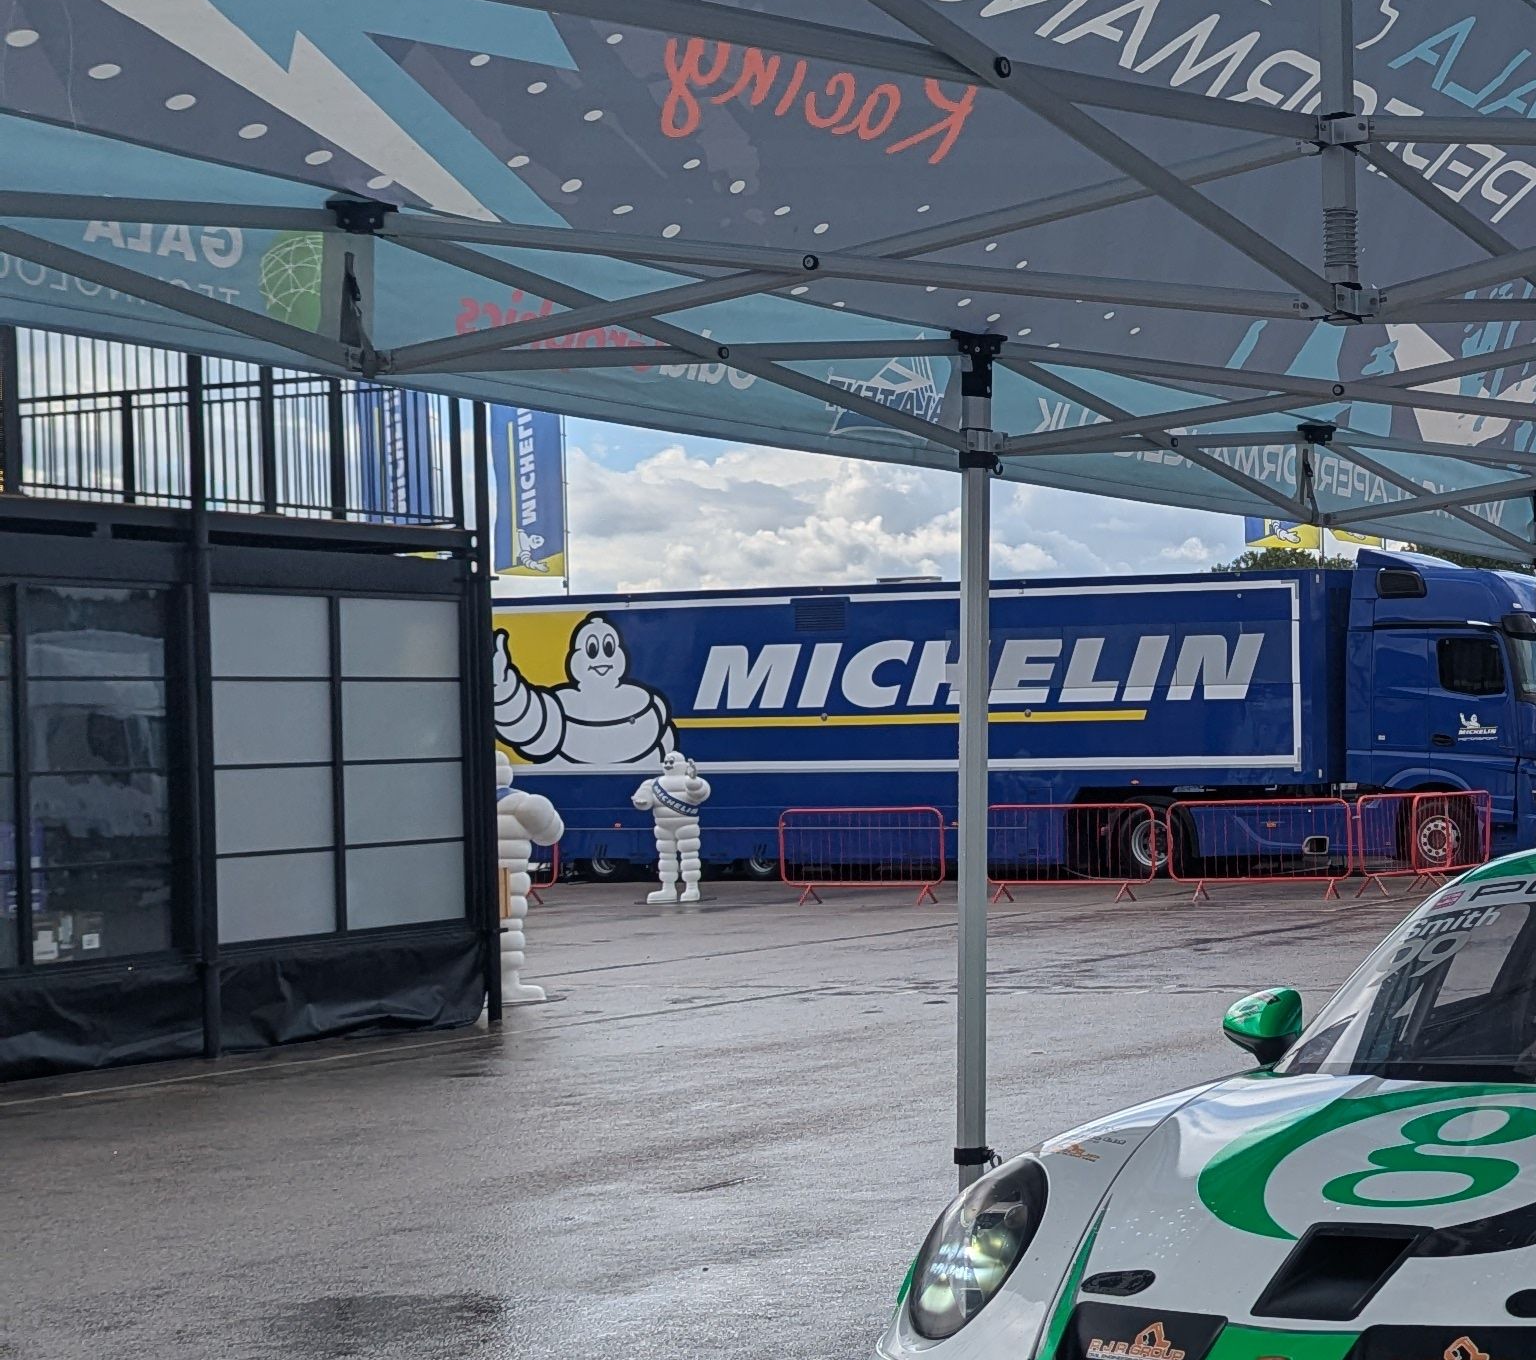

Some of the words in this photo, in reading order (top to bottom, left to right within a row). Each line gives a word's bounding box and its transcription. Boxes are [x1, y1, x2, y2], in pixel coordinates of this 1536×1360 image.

[693, 631, 1265, 710] MICHELIN
[653, 785, 699, 815] MICHELIN
[1407, 906, 1501, 939] Smith
[1129, 1343, 1186, 1360] GROUP
